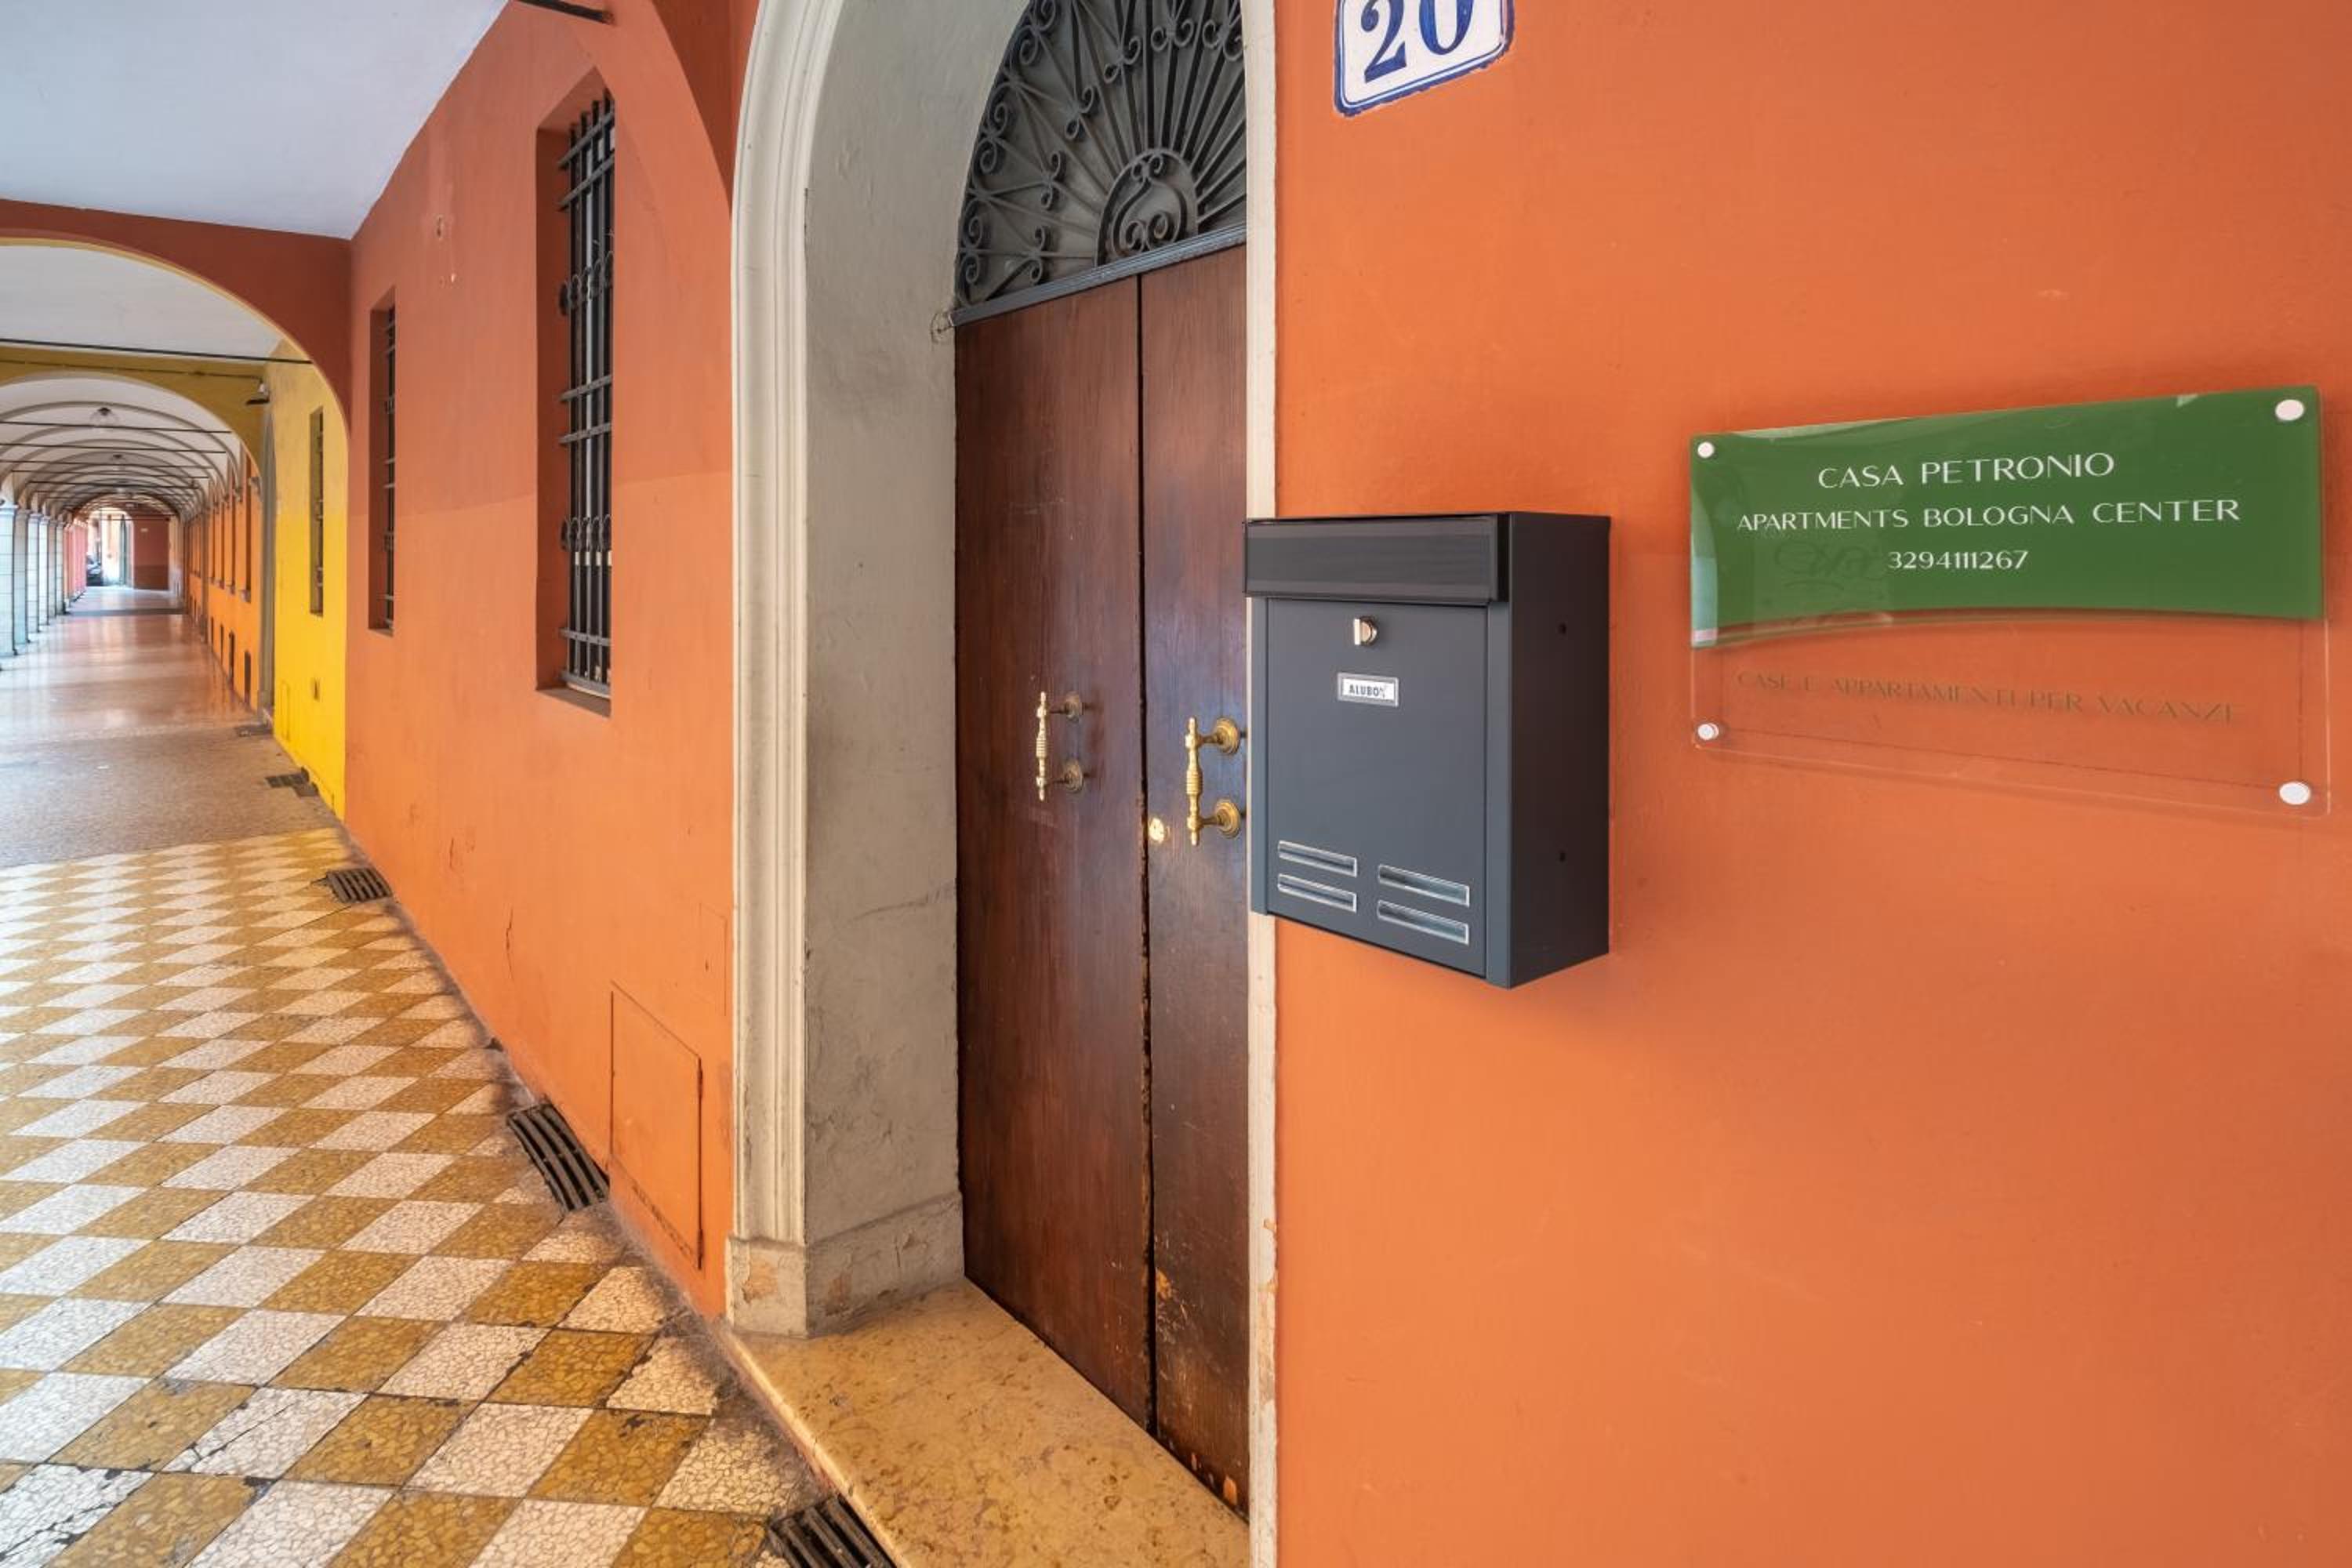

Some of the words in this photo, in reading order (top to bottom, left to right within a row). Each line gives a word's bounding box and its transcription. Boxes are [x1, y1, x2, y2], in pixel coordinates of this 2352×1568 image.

[1360, 0, 1475, 84] 20
[1817, 464, 1904, 488] CASA
[1920, 452, 2115, 485] PETRONIO
[1737, 509, 1910, 531] APARTMENTS
[1923, 504, 2075, 528] BOLOGNA
[2092, 499, 2241, 524] CENTER
[1887, 550, 2030, 570] 3294111267
